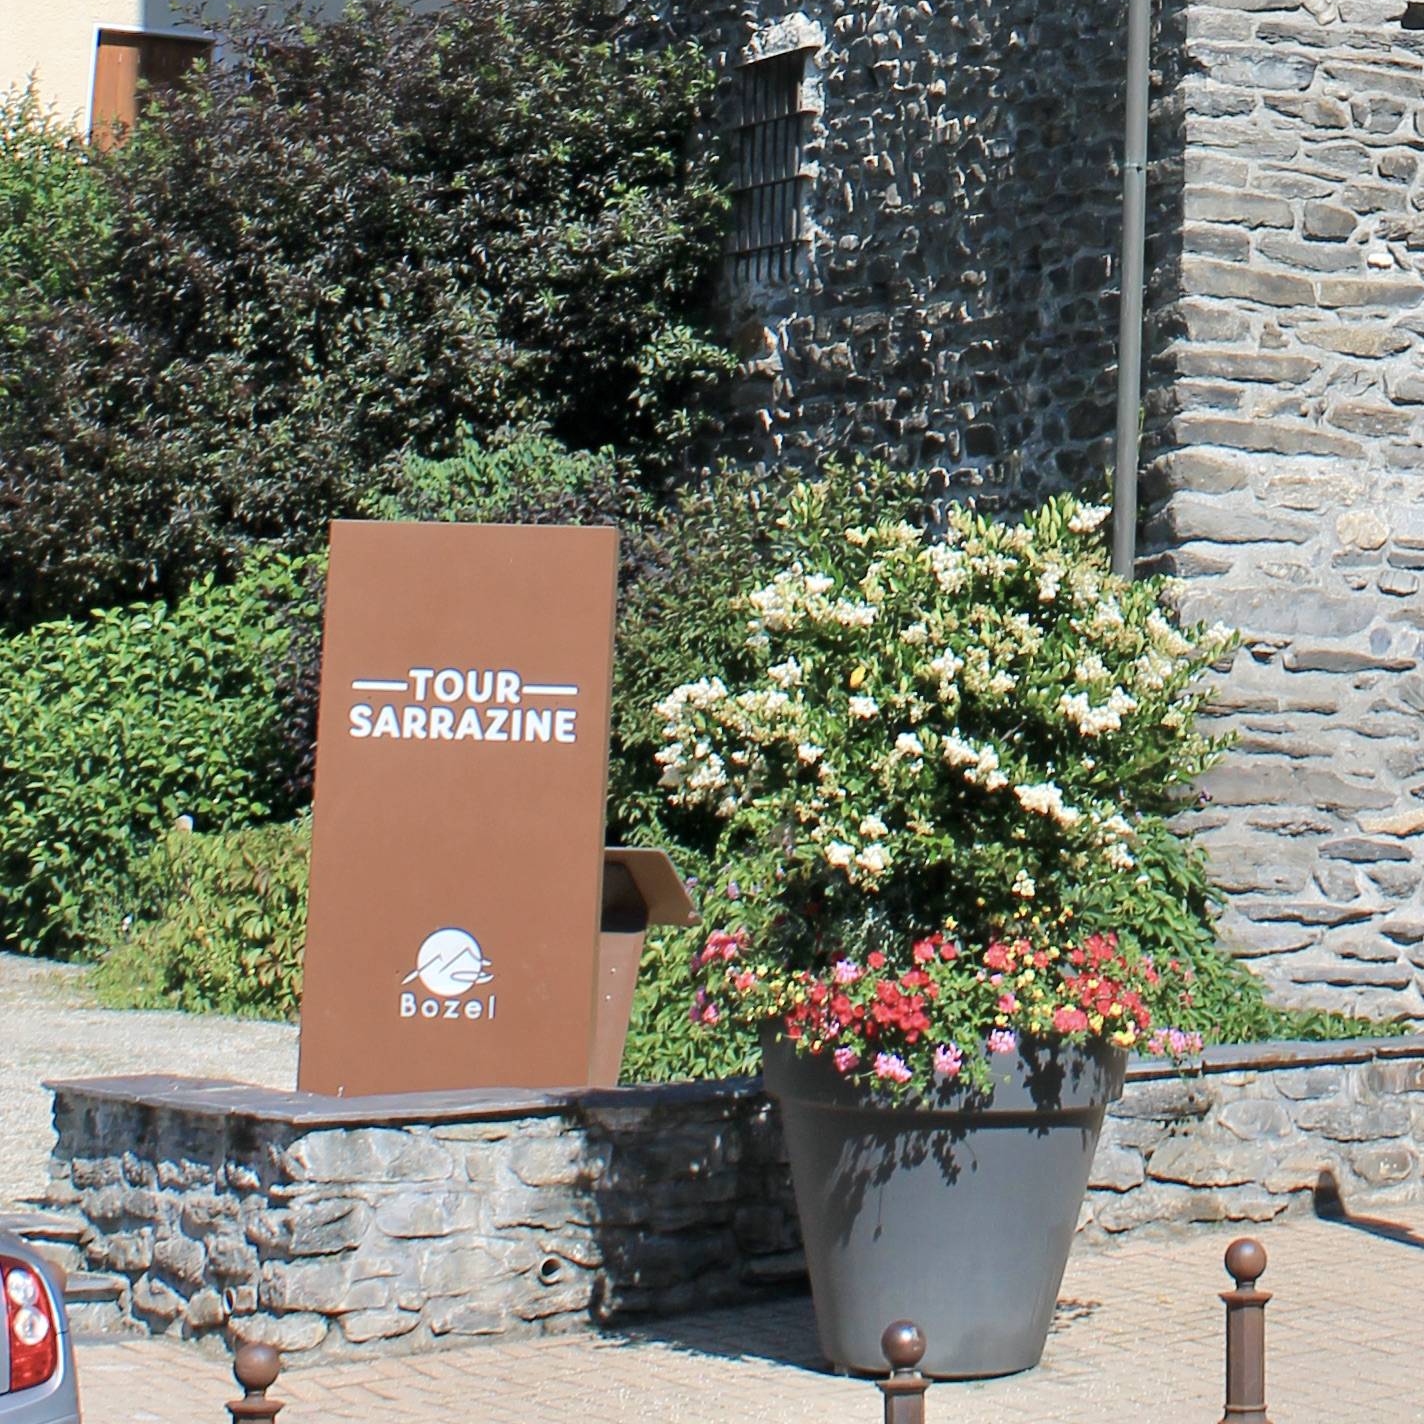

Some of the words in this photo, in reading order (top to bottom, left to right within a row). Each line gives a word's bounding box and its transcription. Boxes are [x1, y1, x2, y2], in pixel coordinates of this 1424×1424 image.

[409, 668, 521, 703] TOUR
[349, 703, 577, 743] SARRAZINE
[400, 992, 496, 1019] Bozel
